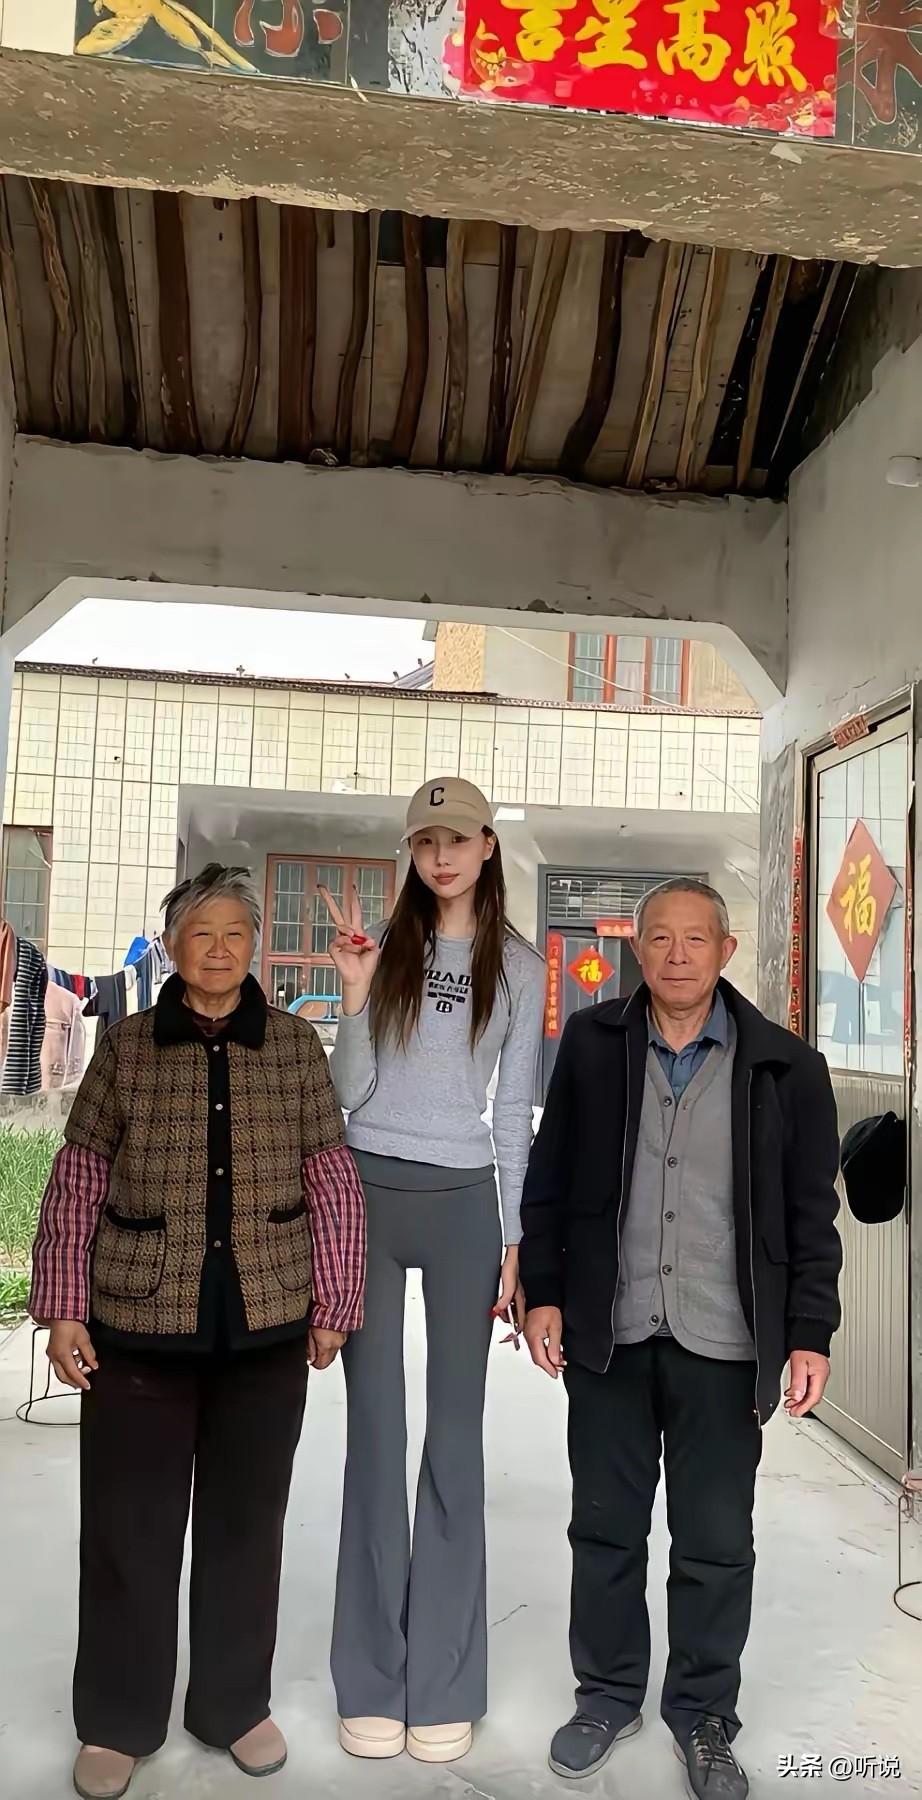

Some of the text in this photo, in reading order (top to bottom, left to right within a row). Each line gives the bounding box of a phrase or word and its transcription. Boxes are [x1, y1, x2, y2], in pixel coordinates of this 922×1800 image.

[501, 0, 808, 90] 吉星高照
[429, 787, 445, 807] C
[840, 854, 877, 941] 福
[577, 959, 603, 983] 福
